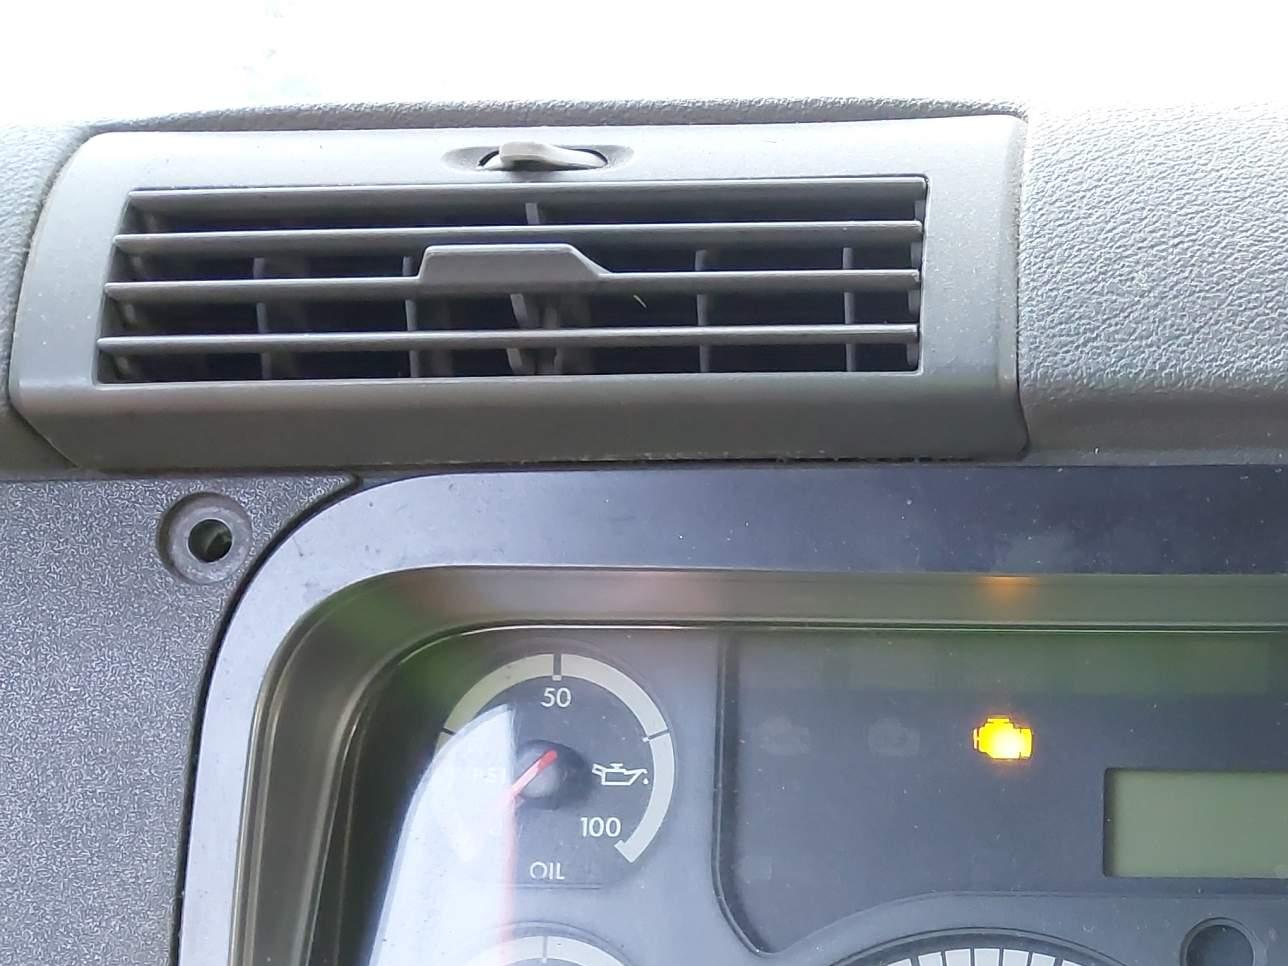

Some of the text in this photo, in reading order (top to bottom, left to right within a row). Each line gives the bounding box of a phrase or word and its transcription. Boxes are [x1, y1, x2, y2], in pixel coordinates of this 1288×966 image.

[540, 687, 573, 708] 50
[580, 816, 622, 838] 100
[529, 861, 566, 881] OIL
